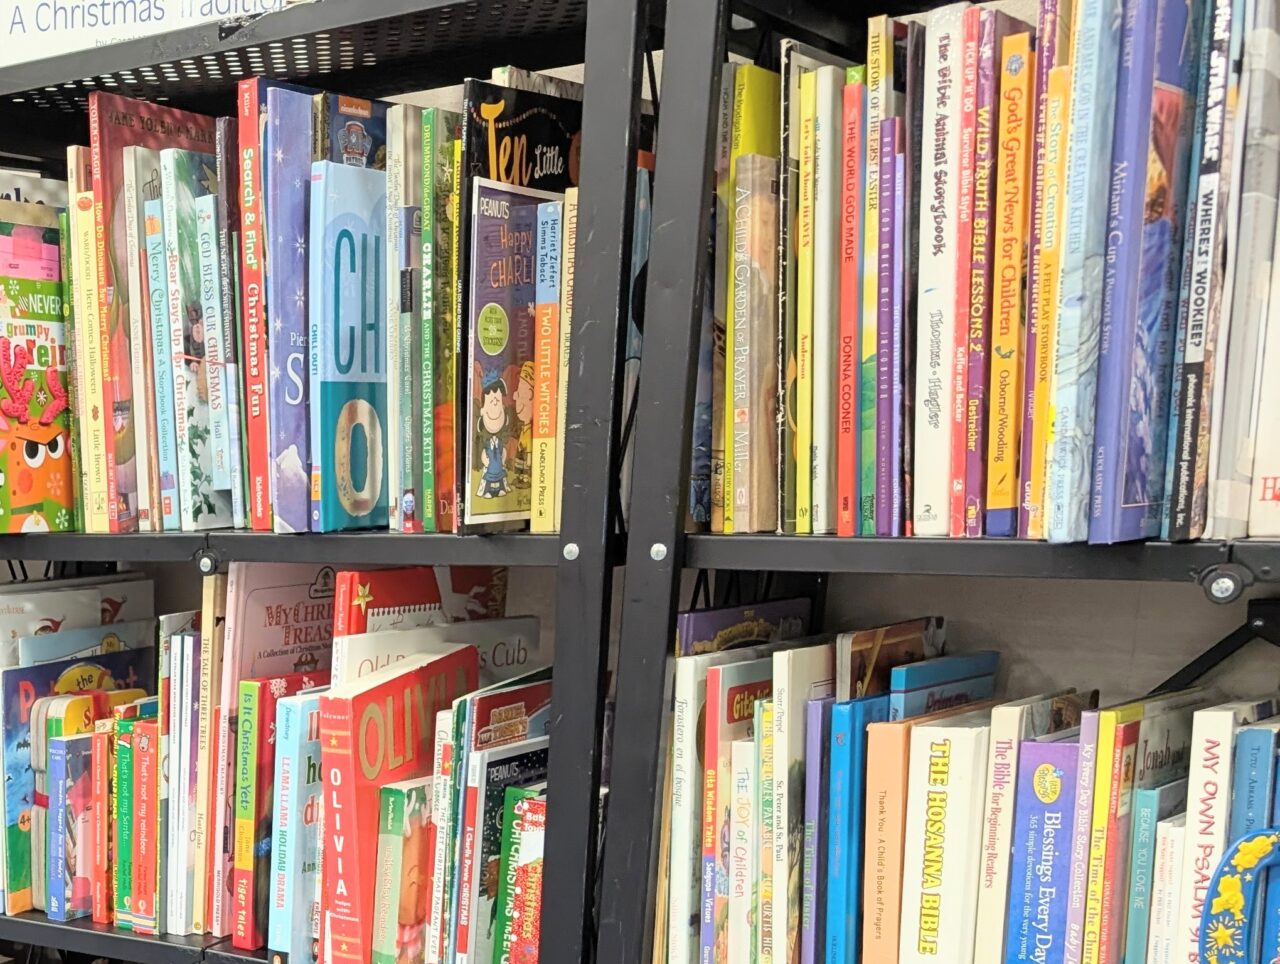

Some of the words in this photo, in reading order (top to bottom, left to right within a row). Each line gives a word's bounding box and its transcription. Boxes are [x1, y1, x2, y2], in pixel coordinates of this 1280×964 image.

[10, 5, 26, 35] A
[35, 0, 165, 32] Christmas
[937, 32, 950, 62] The
[937, 64, 952, 108] Bible
[1004, 87, 1023, 130] God's
[480, 100, 531, 182] Ten
[534, 144, 563, 179] Little
[848, 119, 856, 144] THE
[934, 111, 951, 166] Animal
[846, 147, 856, 190] WORLD
[1002, 138, 1022, 185] Great
[479, 197, 509, 219] PEANUTS
[844, 194, 854, 222] GOD
[931, 168, 948, 257] Storybook
[1003, 190, 1019, 233] News
[1109, 160, 1128, 228] Miriam's
[500, 224, 532, 256] Happy
[541, 220, 549, 246] Simms
[844, 224, 854, 262] MADE
[1197, 190, 1214, 256] WHERE'S
[540, 249, 548, 284] Taback
[1001, 238, 1018, 259] for
[1107, 230, 1123, 264] Cup
[28, 294, 62, 315] NEVER
[542, 306, 551, 334] TWO
[1000, 261, 1016, 336] Children
[1190, 266, 1207, 348] WOOKIEE?
[7, 322, 50, 341] grumpy
[248, 283, 260, 378] Christmas
[540, 337, 550, 381] LITTLE
[842, 336, 852, 381] DONNA
[251, 381, 261, 418] Fun
[538, 384, 549, 434] WITCHES
[841, 386, 851, 434] COONER
[994, 369, 1009, 462] Osborne/Wooding
[734, 430, 749, 472] Miller
[490, 642, 528, 667] Cub
[76, 673, 94, 690] the
[489, 760, 519, 781] PEANUTS
[929, 738, 951, 787] THE
[328, 768, 347, 897] OLIVIA
[922, 790, 948, 889] HOSANNA
[1035, 811, 1062, 882] Blessings
[237, 878, 247, 906] tiger
[1030, 886, 1056, 934] Every
[236, 910, 246, 938] tales
[918, 893, 941, 955] BIBLE
